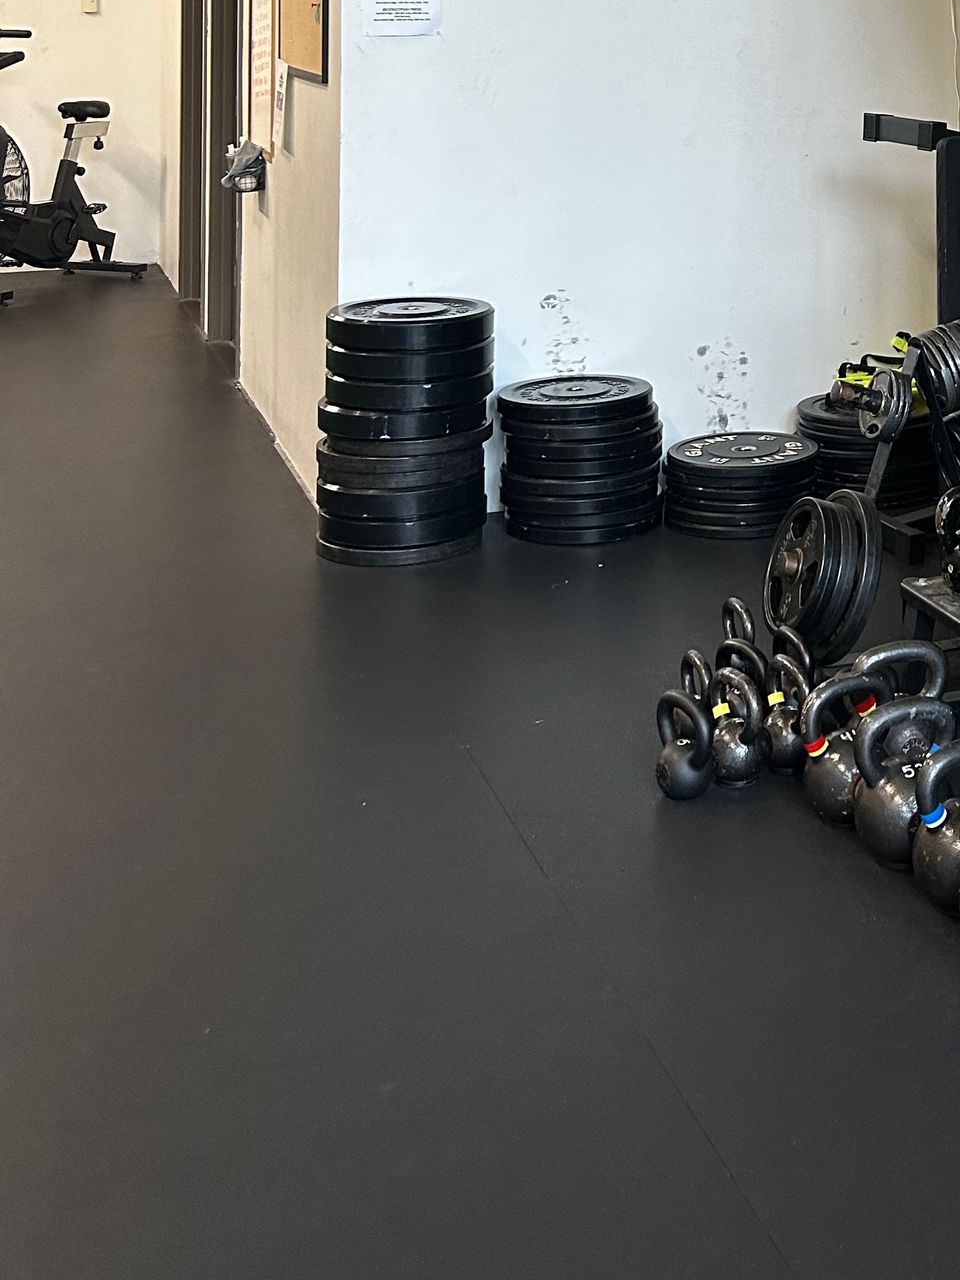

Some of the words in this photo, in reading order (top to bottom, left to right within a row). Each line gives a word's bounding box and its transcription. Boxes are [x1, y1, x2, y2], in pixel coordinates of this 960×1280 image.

[684, 434, 738, 457] GIANT
[751, 441, 803, 464] GIANT
[839, 729, 857, 743] 4
